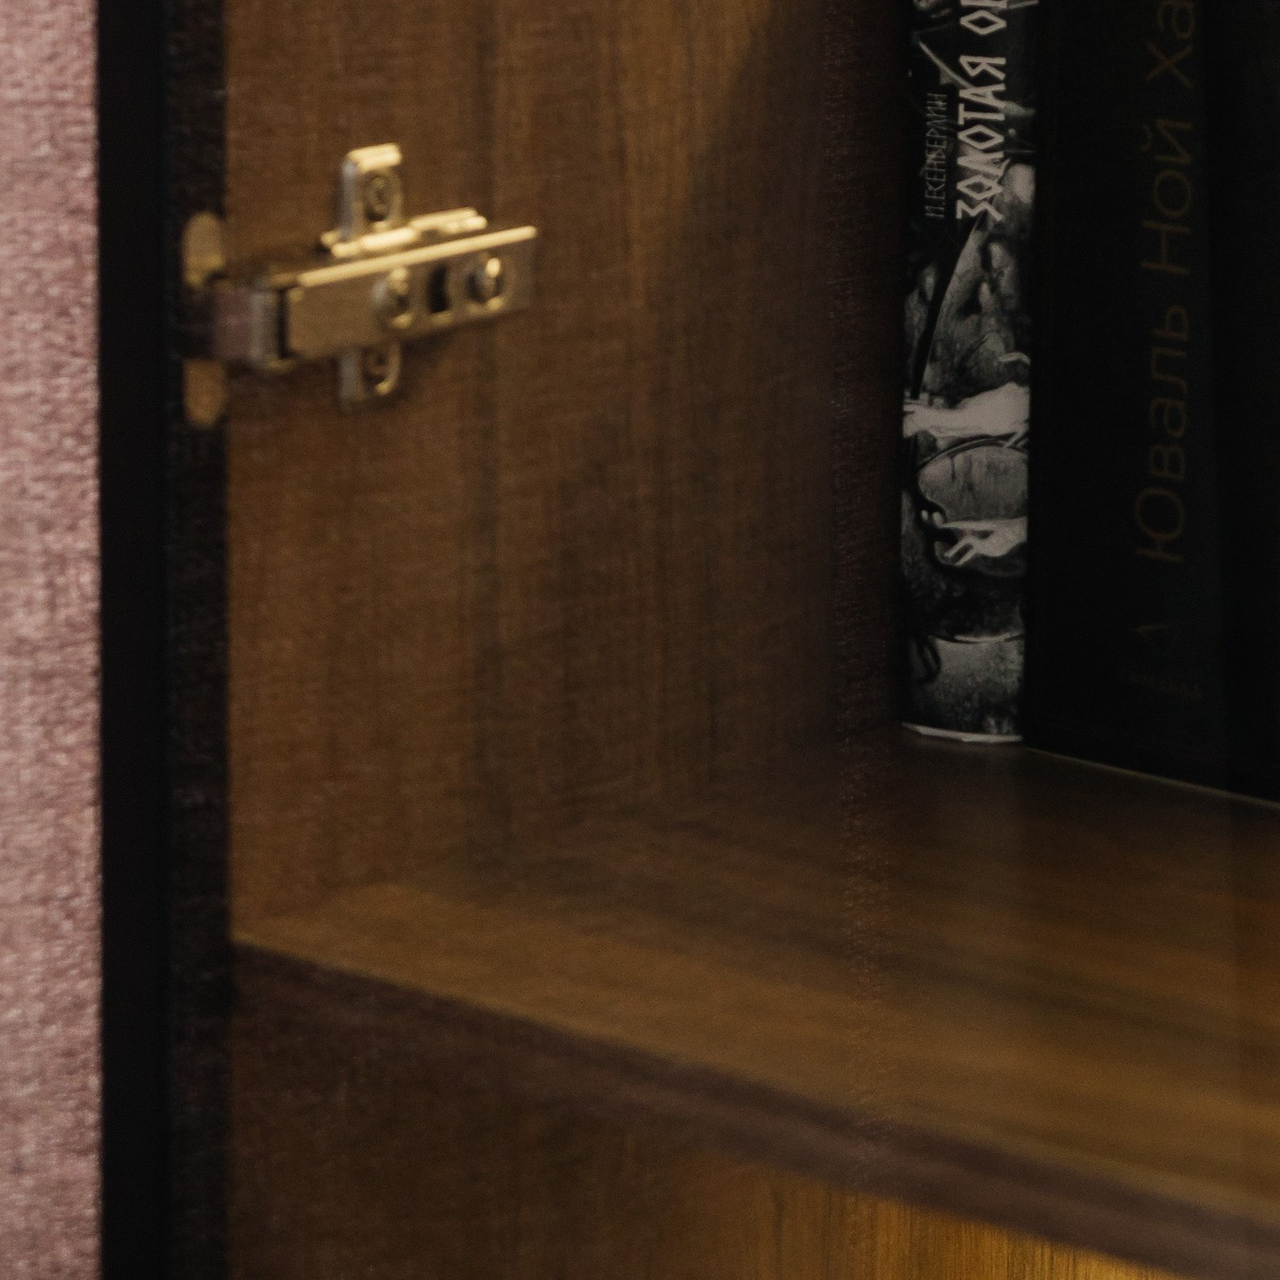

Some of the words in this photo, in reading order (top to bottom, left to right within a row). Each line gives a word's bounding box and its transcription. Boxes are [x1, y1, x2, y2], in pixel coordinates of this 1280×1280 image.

[955, 53, 1007, 222] ЗОЛОТАЯ
[1136, 118, 1197, 277] Ной
[1133, 304, 1190, 566] Юваль
